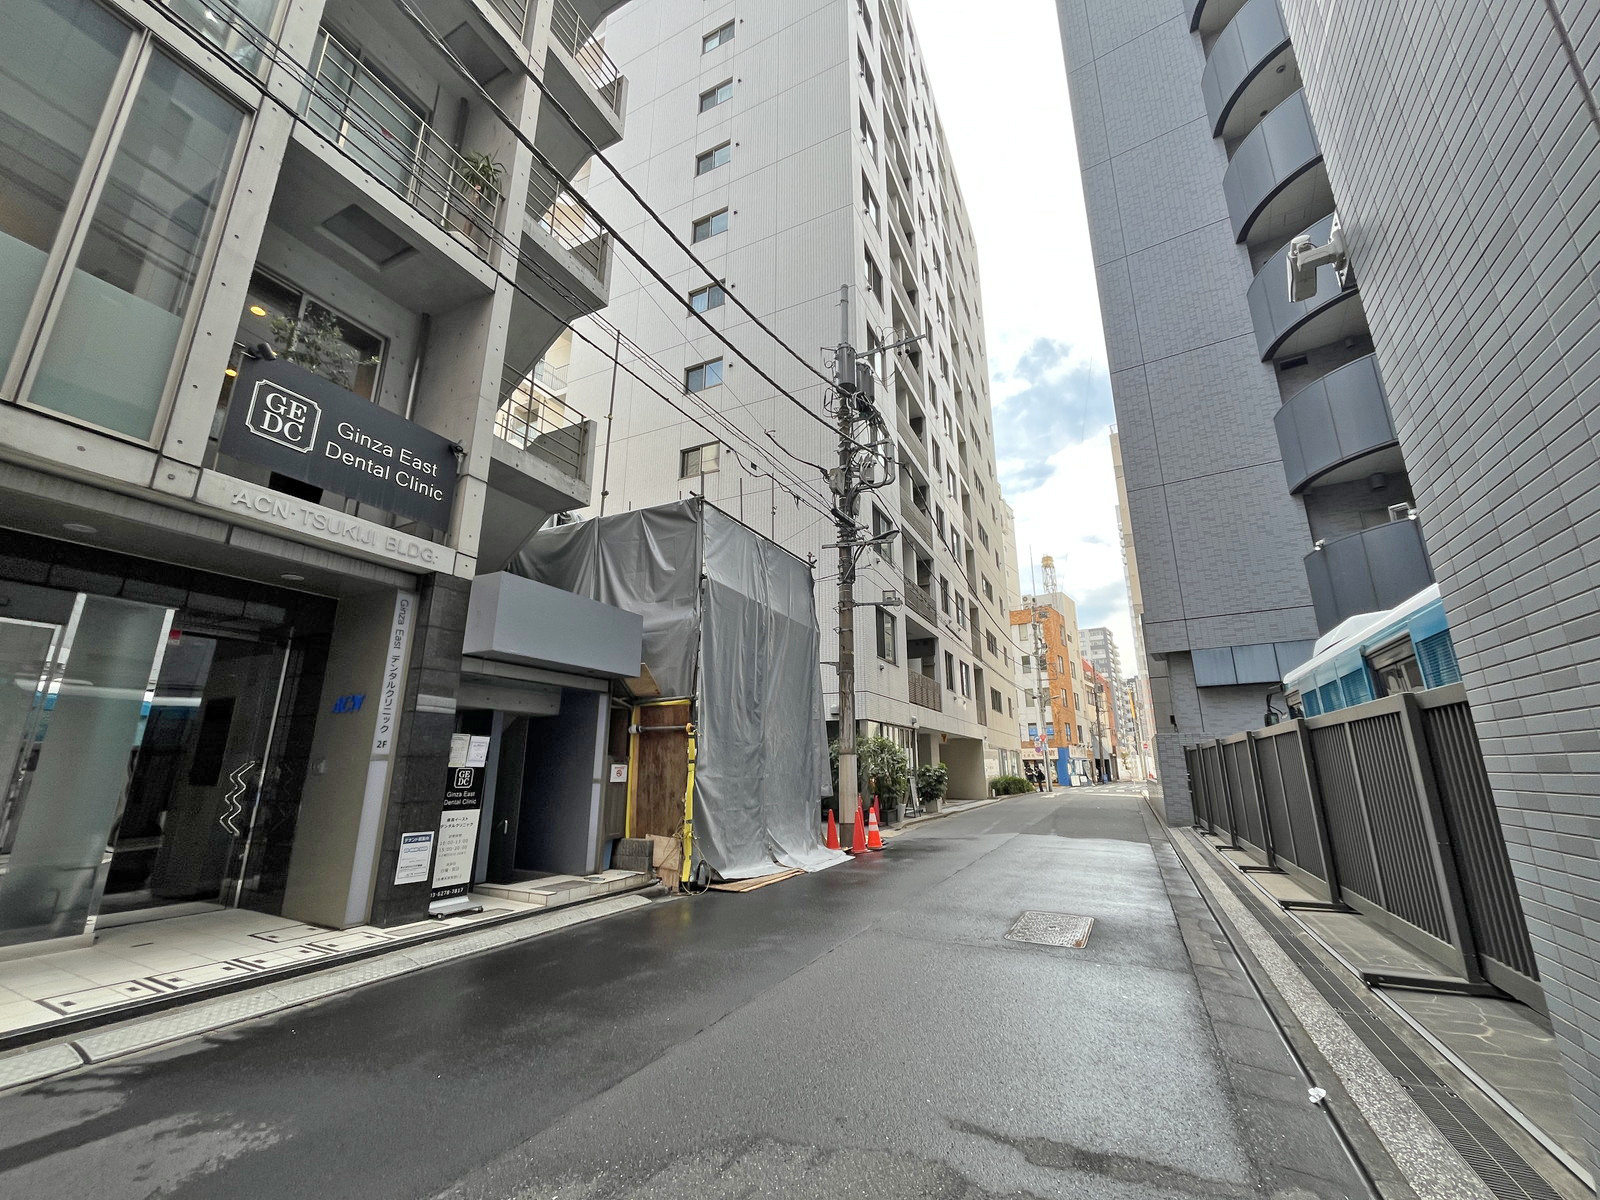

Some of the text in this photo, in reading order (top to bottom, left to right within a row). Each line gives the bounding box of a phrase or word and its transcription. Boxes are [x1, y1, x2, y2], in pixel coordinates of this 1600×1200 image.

[260, 410, 304, 442] DC
[265, 393, 307, 424] GE
[325, 441, 443, 501] Dental Clinic
[337, 421, 438, 477] Ginza East
[376, 599, 409, 749] Ginza East デンタルクリニック 2F
